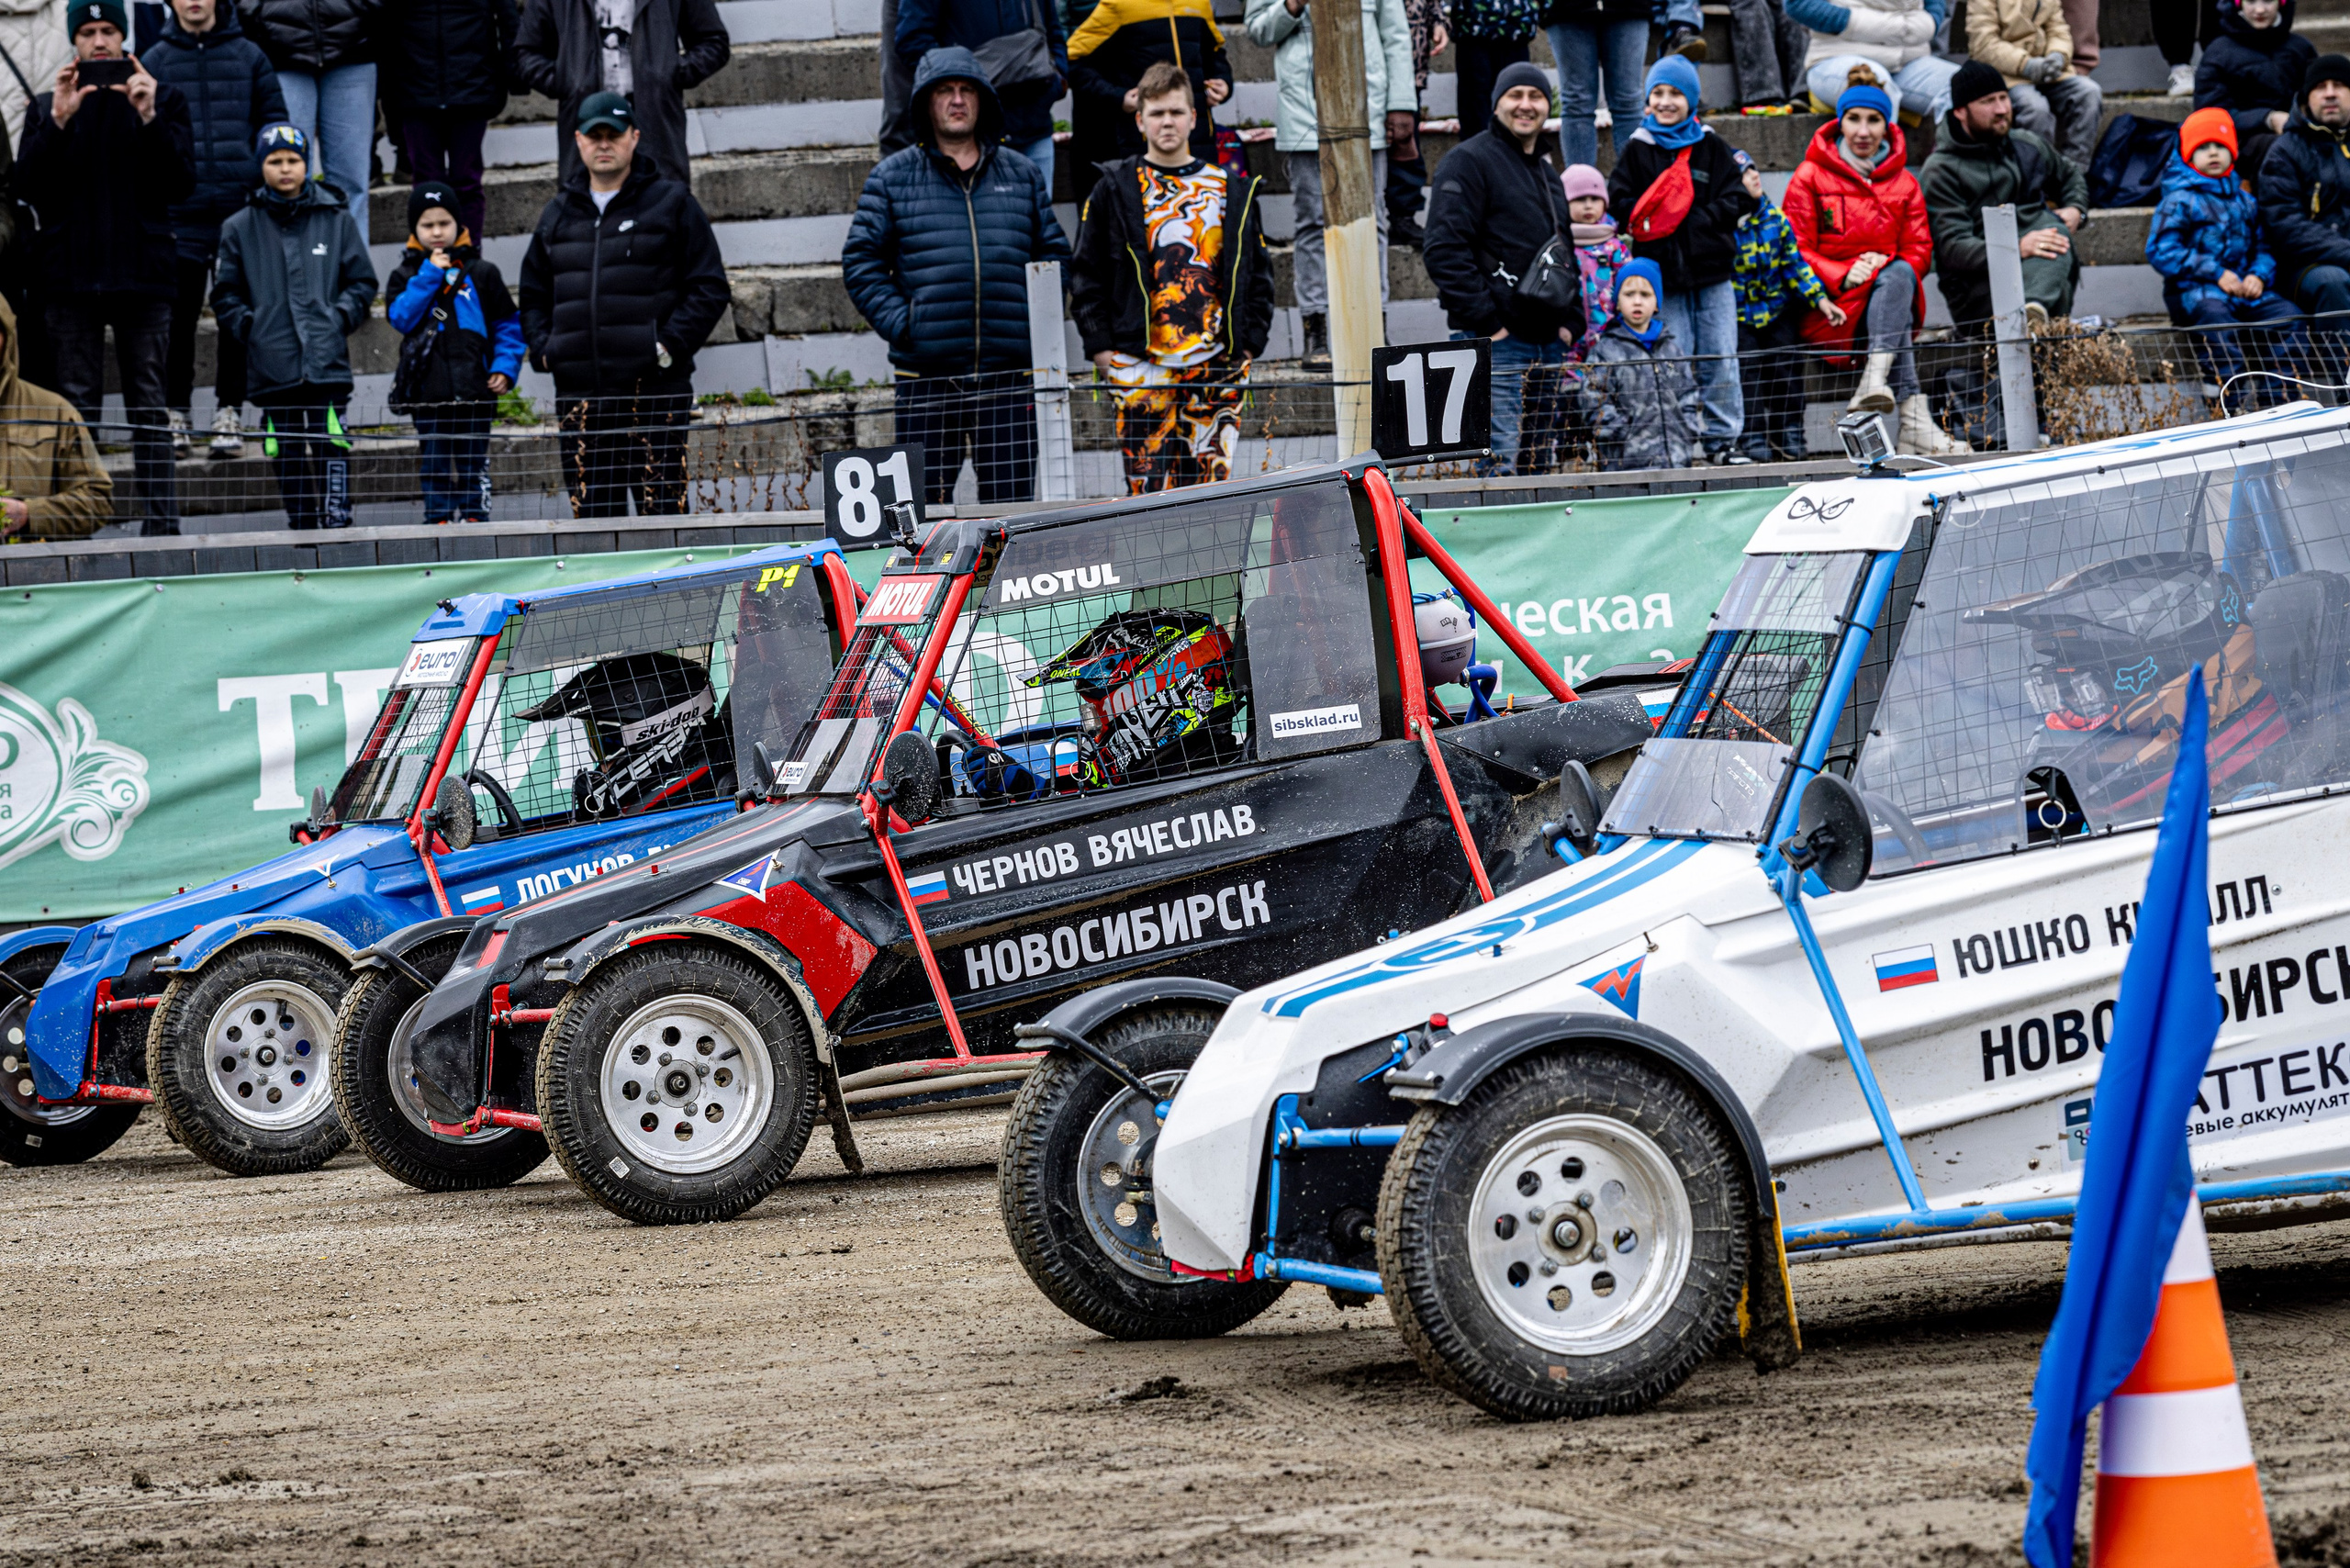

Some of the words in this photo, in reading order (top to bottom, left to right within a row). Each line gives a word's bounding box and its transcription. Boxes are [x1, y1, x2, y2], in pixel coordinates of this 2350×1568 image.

[1386, 349, 1477, 447] 17
[834, 451, 913, 538] 81
[755, 564, 800, 593] P1
[865, 582, 934, 617] MOTUL
[1001, 563, 1121, 603] MOTUL
[418, 644, 465, 670] eurol
[1274, 712, 1359, 732] sibsklad.ru
[952, 842, 1080, 895] ЧЕРНОВ
[1088, 804, 1257, 868] ВЯЧЕСЛАВ
[964, 879, 1271, 991] НОВОСИБИРСК
[1953, 913, 2091, 979] ЮШКО
[2105, 874, 2273, 946] КЛЛ
